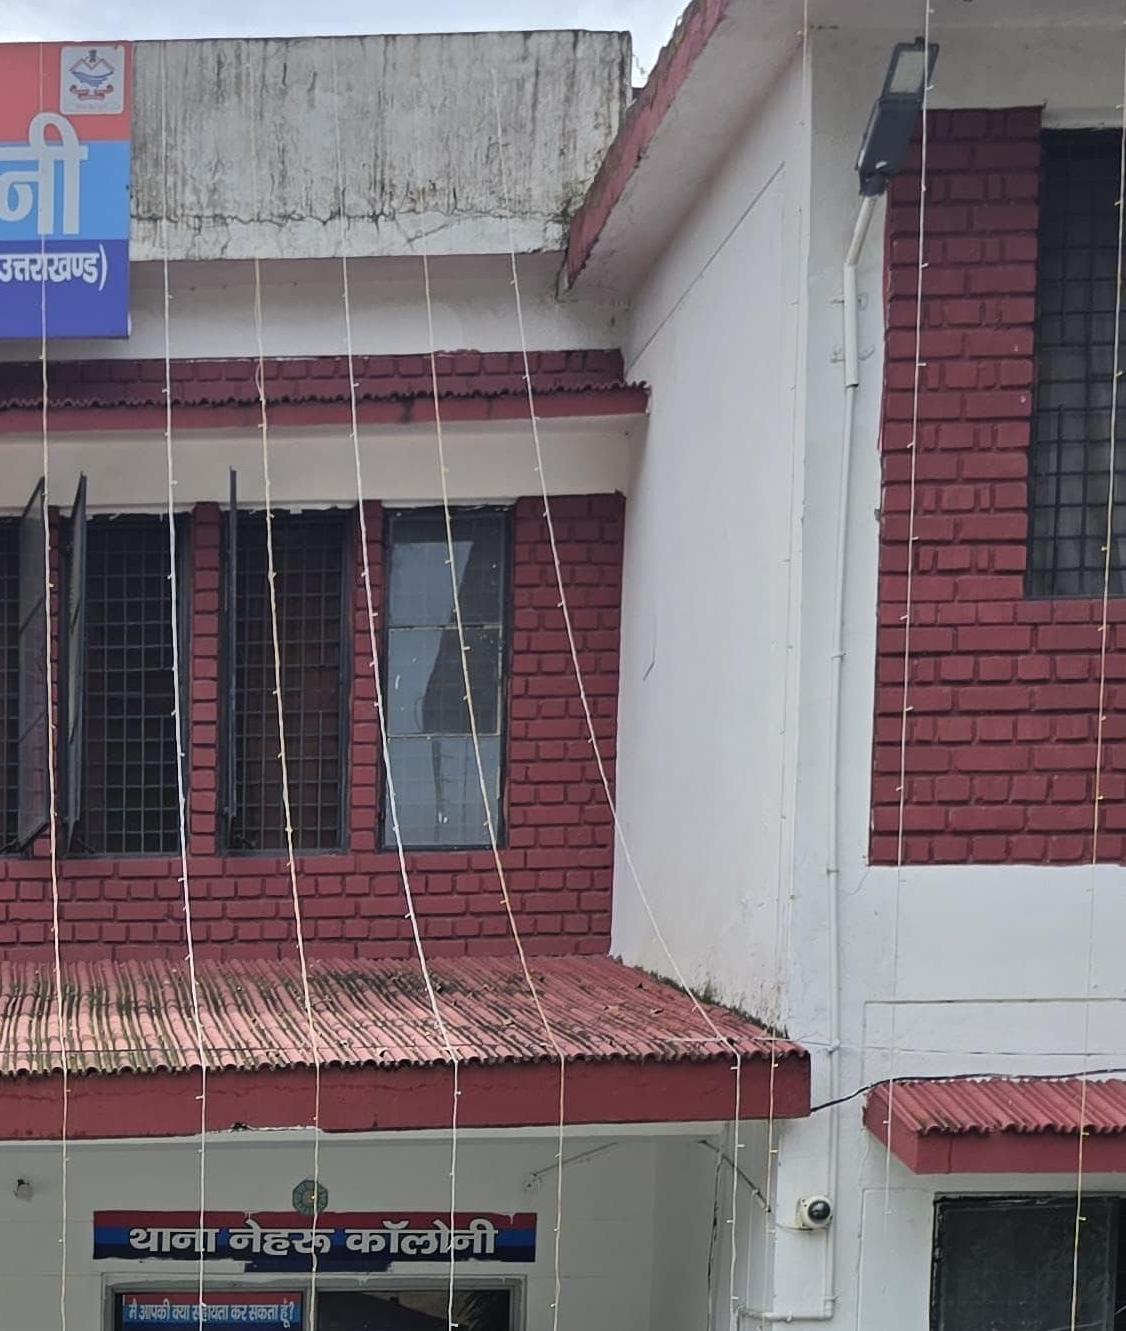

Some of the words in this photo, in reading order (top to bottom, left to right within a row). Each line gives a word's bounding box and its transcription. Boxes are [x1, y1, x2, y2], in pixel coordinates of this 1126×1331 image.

[129, 1228, 219, 1253] थाना
[228, 1218, 335, 1255] नेहरू
[345, 1219, 498, 1254] कॉलोनी
[230, 1305, 247, 1320] कर
